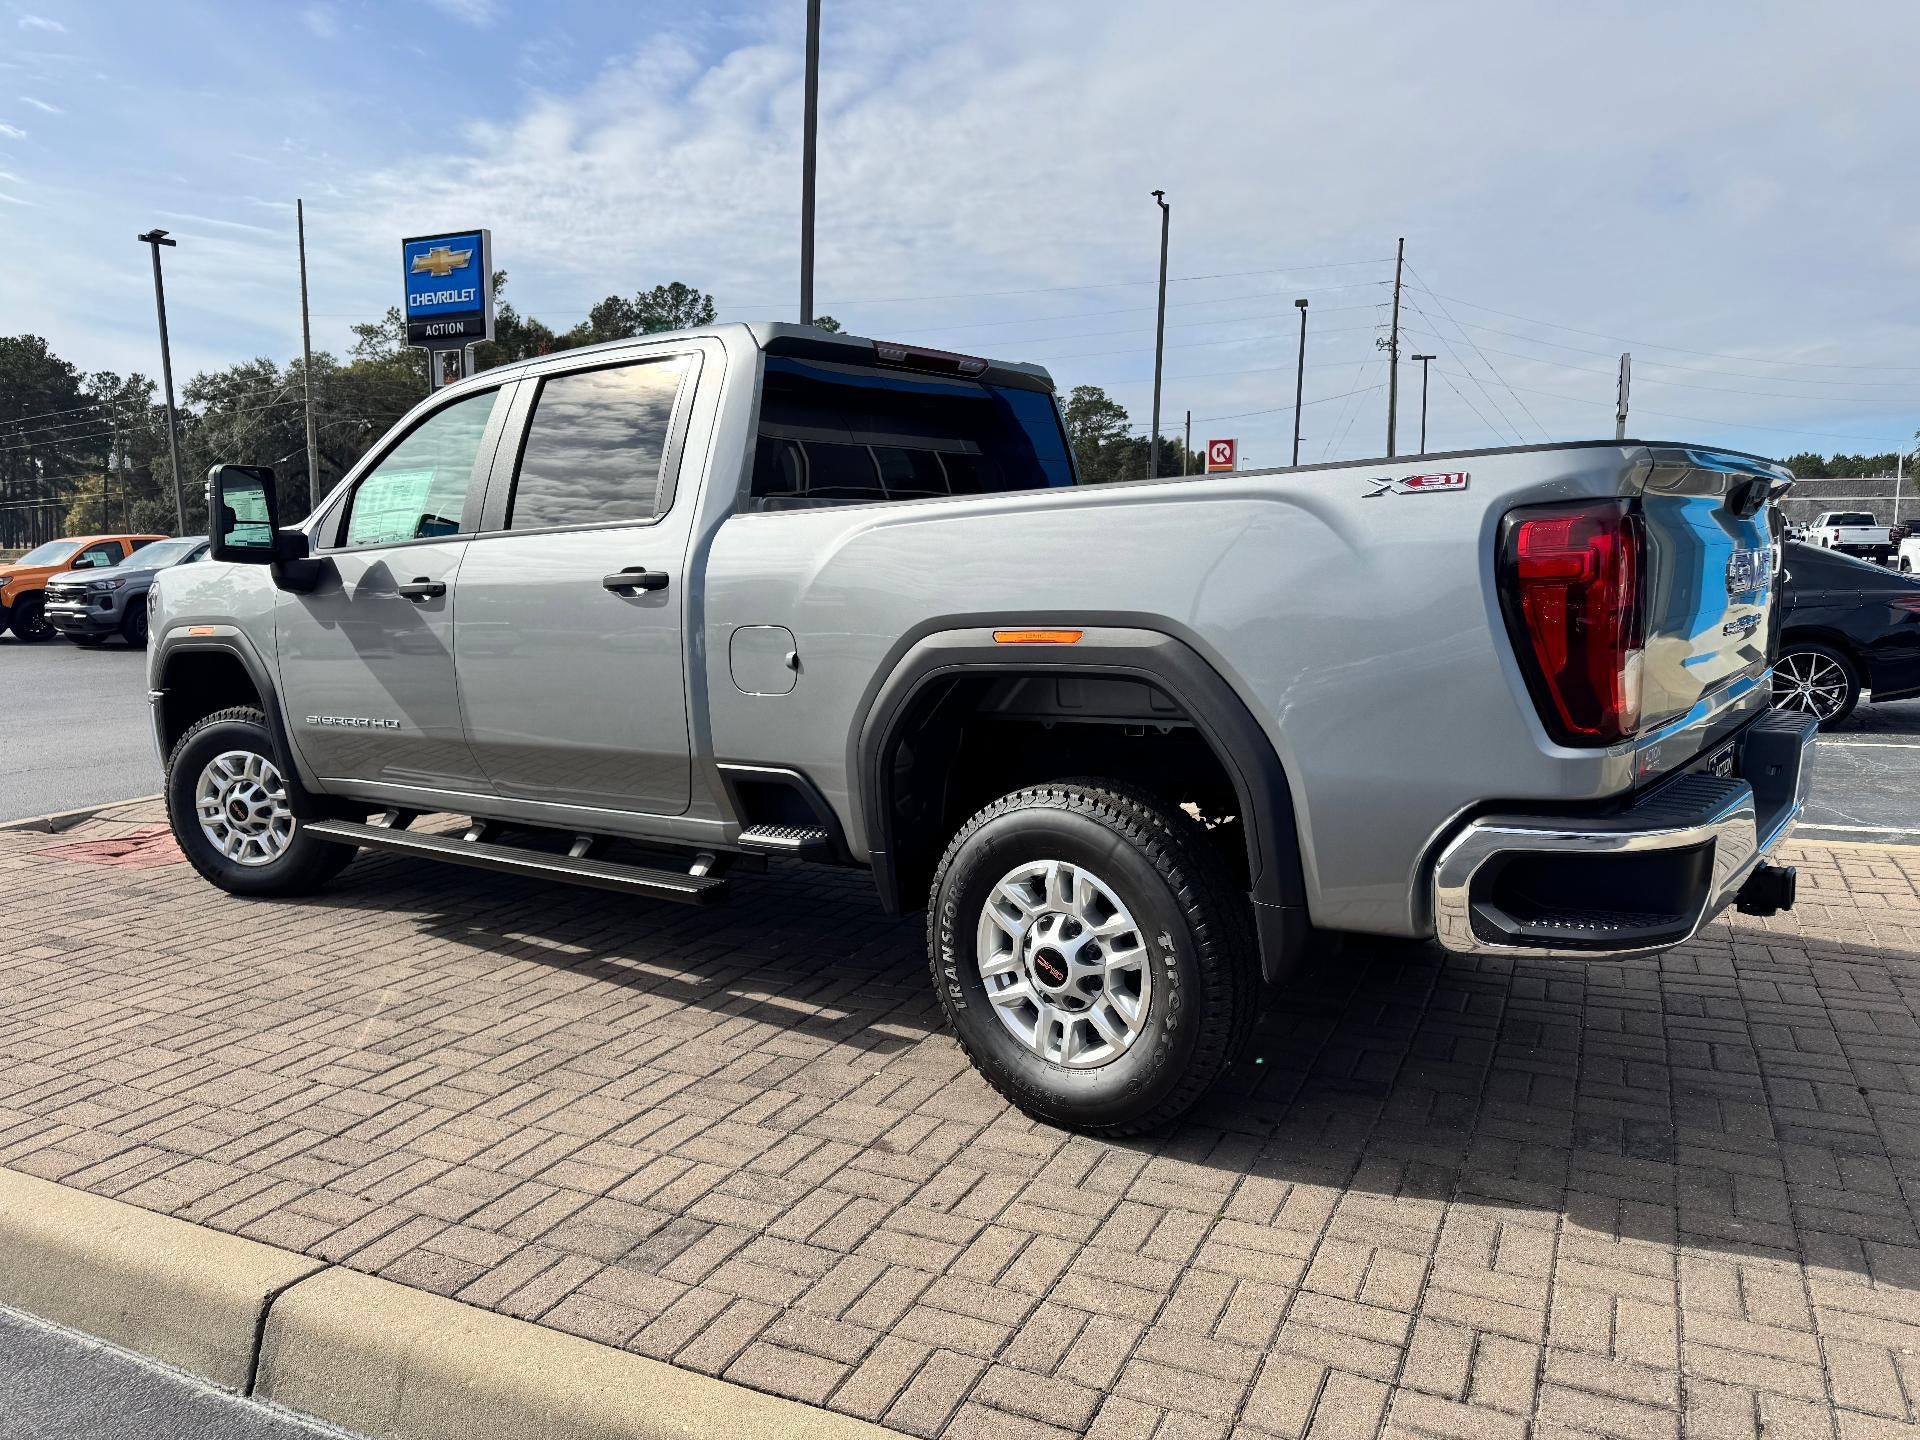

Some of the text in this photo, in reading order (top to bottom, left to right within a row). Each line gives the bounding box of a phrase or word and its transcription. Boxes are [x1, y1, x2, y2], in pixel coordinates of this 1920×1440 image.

[409, 288, 476, 307] CHEVROLET
[425, 321, 464, 337] ACTION
[305, 715, 400, 729] SIERRA HD
